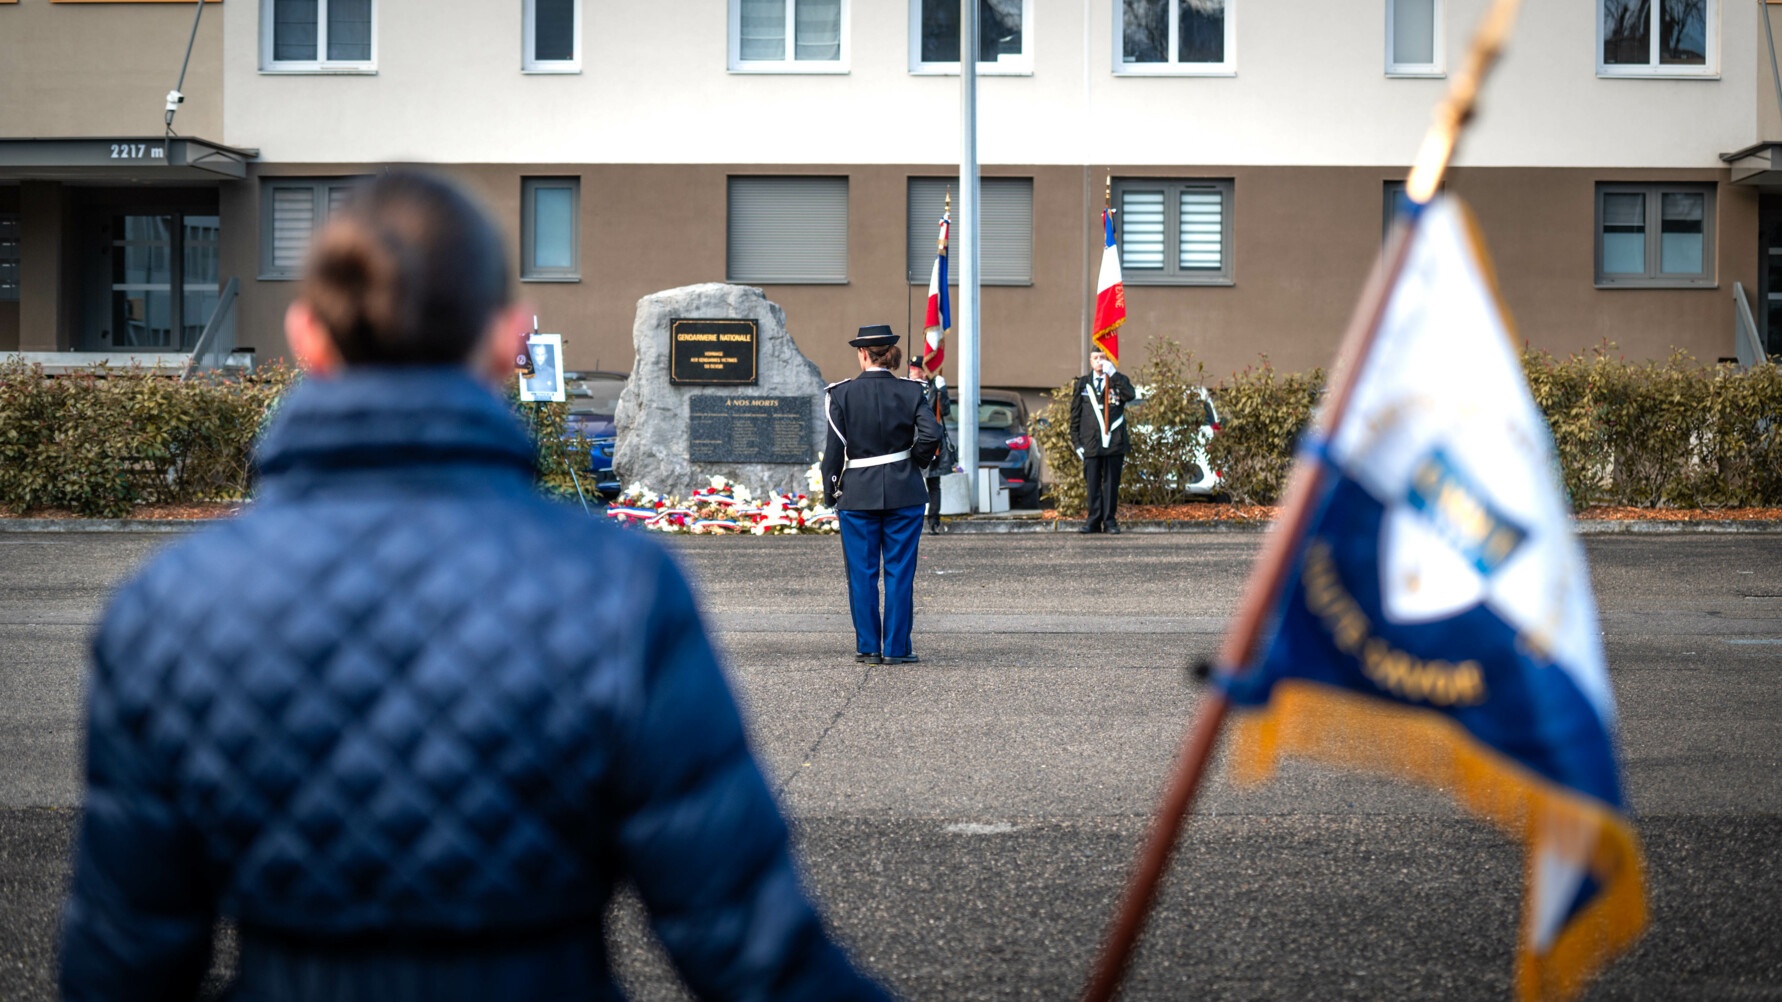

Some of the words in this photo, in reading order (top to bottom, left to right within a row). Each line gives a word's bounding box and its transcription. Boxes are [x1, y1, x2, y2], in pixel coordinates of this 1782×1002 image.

[110, 144, 146, 158] 2217
[150, 147, 164, 158] m
[677, 334, 718, 342] GENDARMERIE
[719, 334, 751, 342] NATIONALE
[725, 398, 731, 406] À
[751, 399, 779, 407] MORTS
